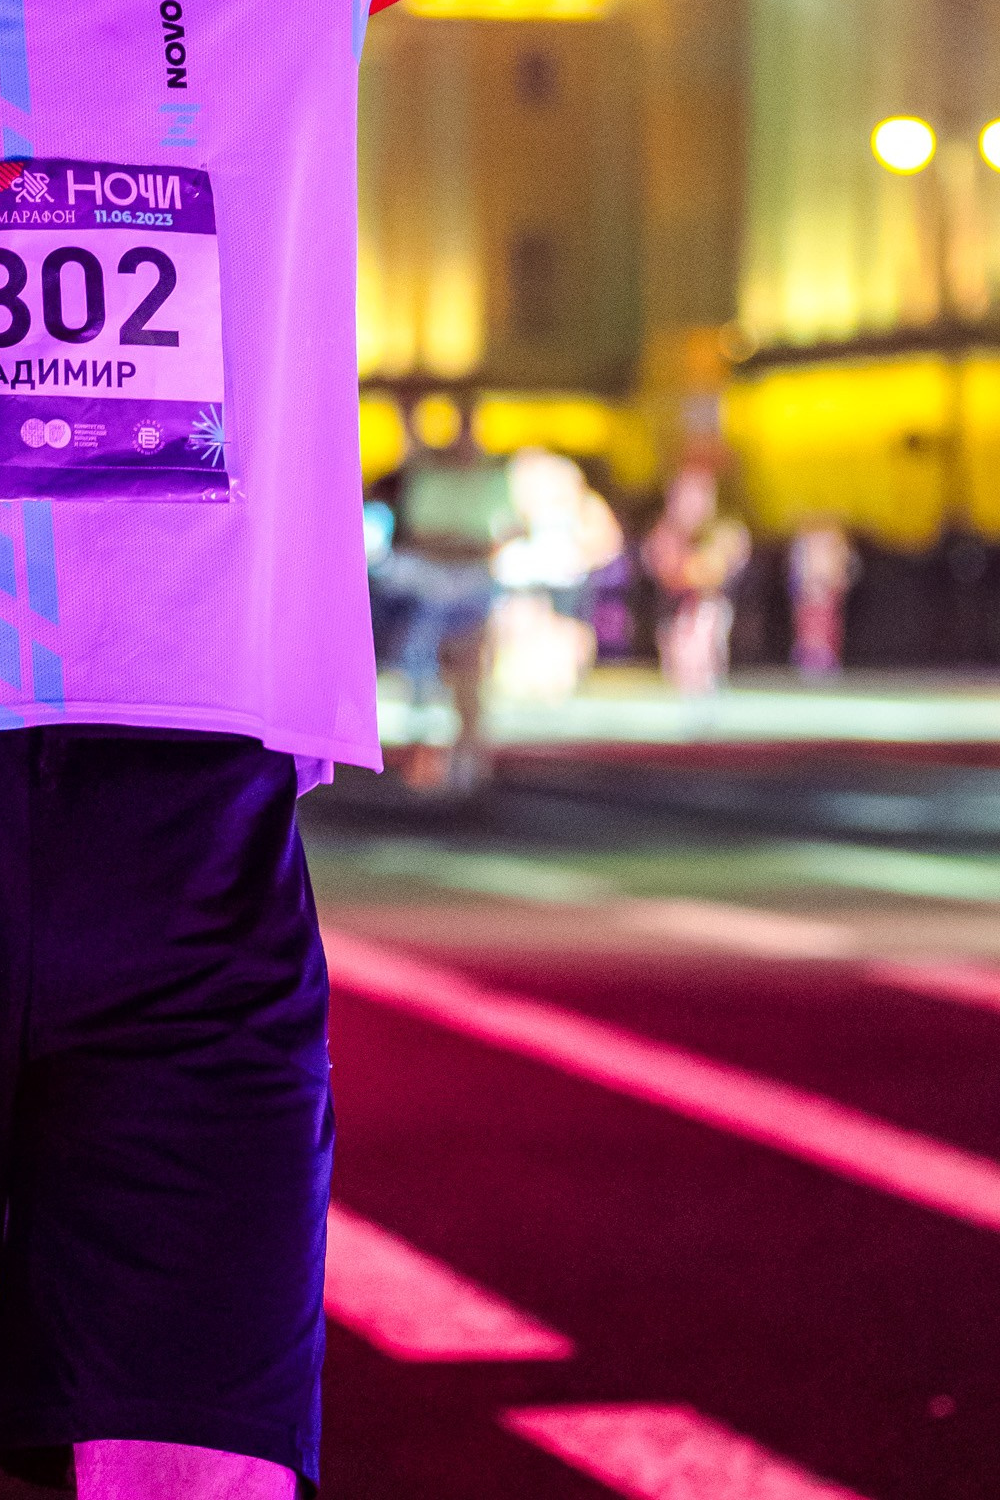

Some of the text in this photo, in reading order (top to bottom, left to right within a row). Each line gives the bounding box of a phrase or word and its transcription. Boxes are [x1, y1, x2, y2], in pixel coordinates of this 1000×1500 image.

[159, 0, 188, 89] NOVO
[67, 169, 183, 211] НОЧИ
[94, 209, 174, 227] 11.06.2023
